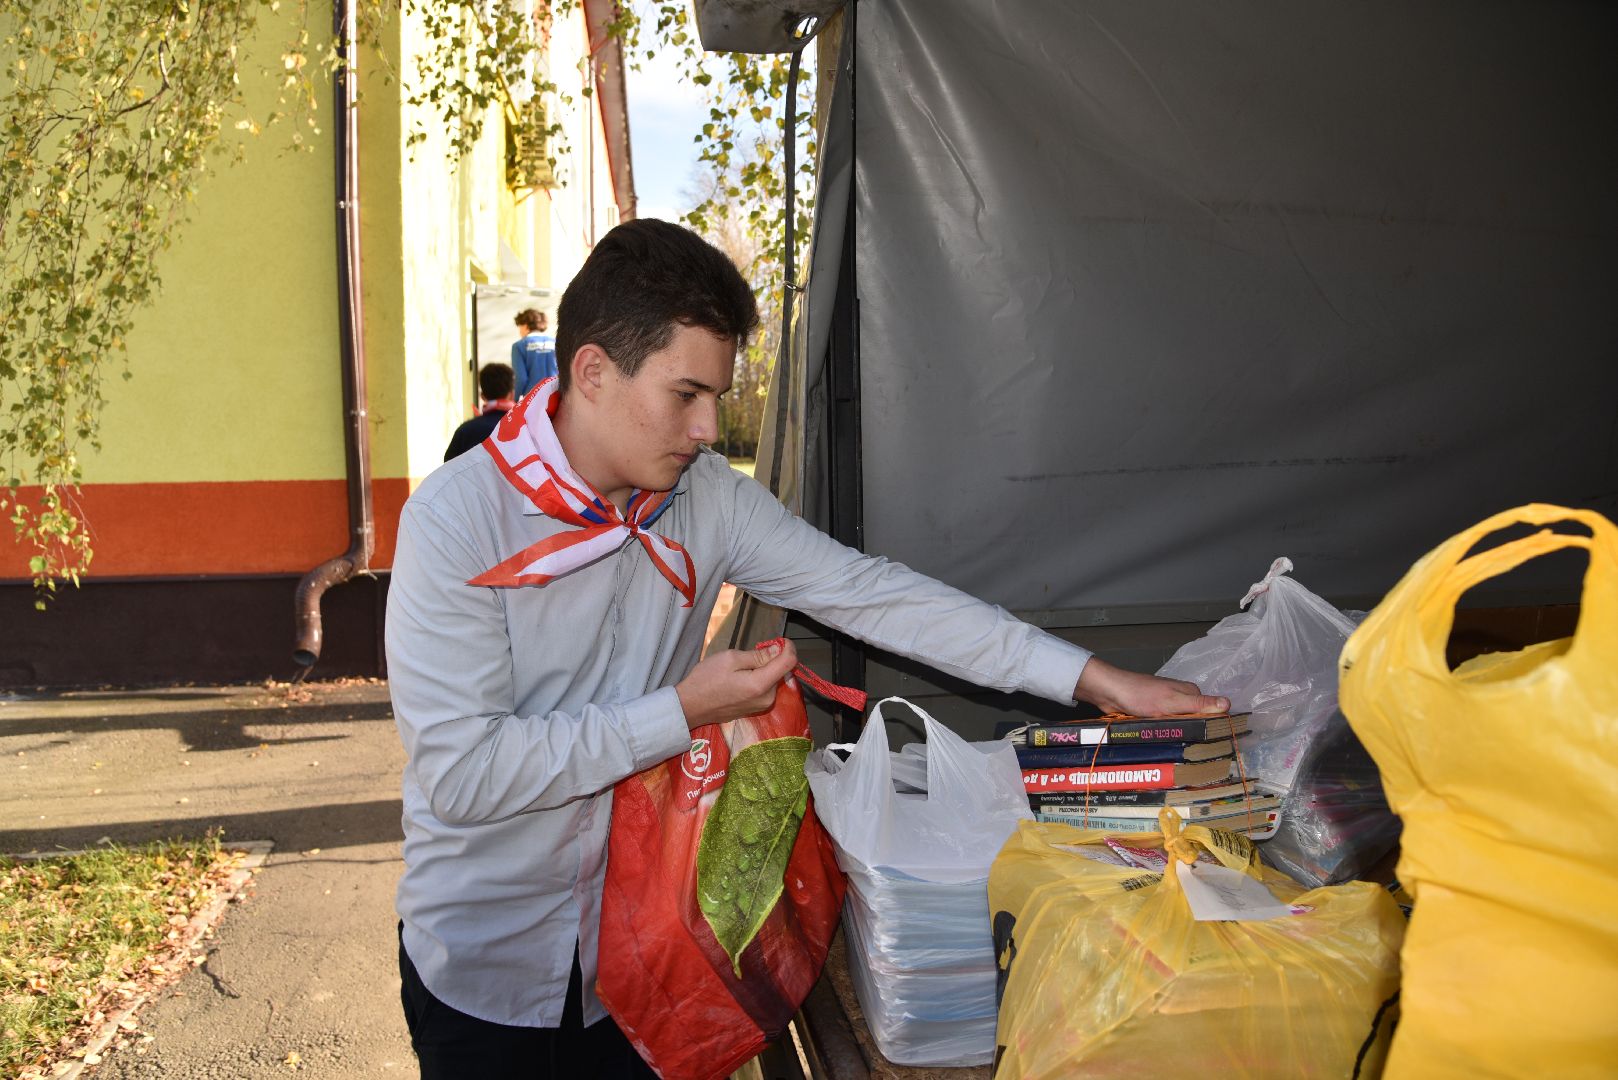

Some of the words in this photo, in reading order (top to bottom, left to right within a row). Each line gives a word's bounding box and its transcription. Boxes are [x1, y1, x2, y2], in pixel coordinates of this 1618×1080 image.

[1140, 729, 1153, 739] КТО
[1154, 729, 1170, 739] ЕСТЬ
[1170, 728, 1183, 738] КТО
[1040, 773, 1049, 786] А
[1051, 773, 1066, 783] от
[1069, 768, 1161, 785] САМОПОМОЩЬ
[686, 770, 726, 800] Пятрочка
